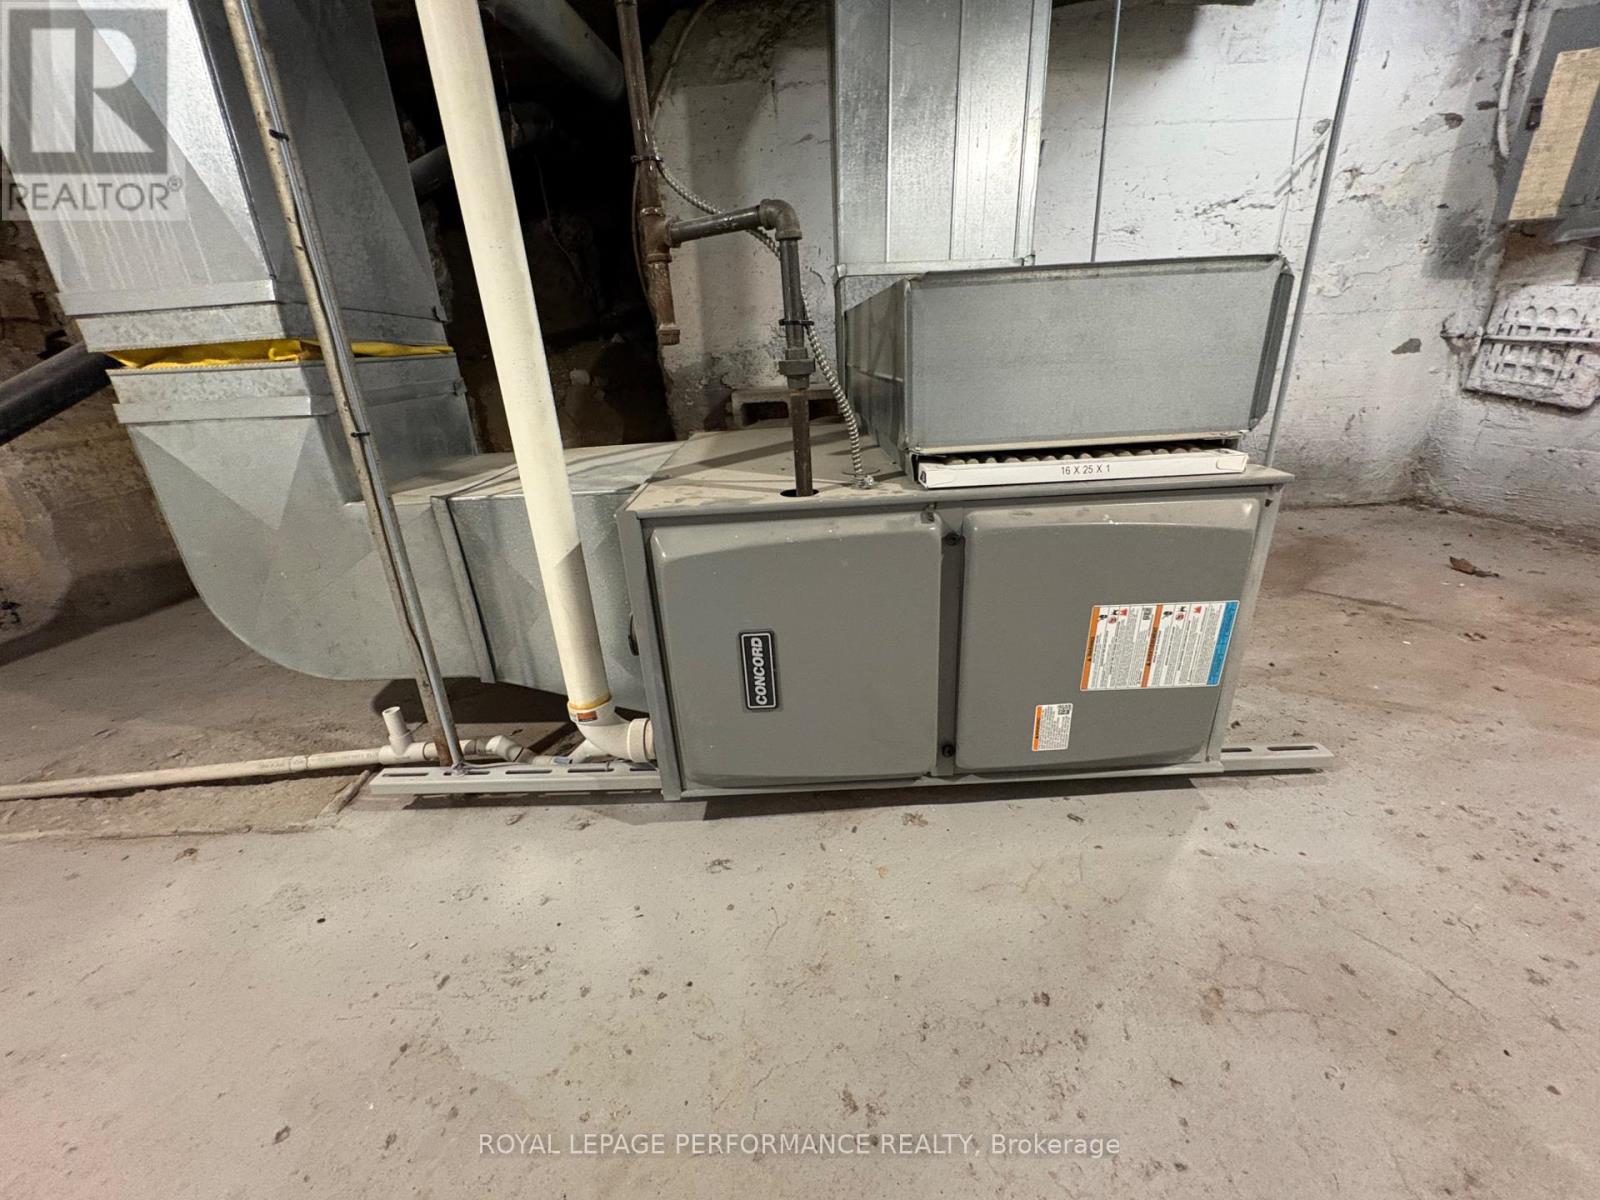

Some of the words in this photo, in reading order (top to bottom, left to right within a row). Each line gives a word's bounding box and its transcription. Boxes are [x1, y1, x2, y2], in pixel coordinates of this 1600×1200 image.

[1061, 466, 1071, 475] 16
[1083, 464, 1094, 474] 25
[1106, 464, 1110, 473] 1
[750, 637, 768, 705] CONCORD
